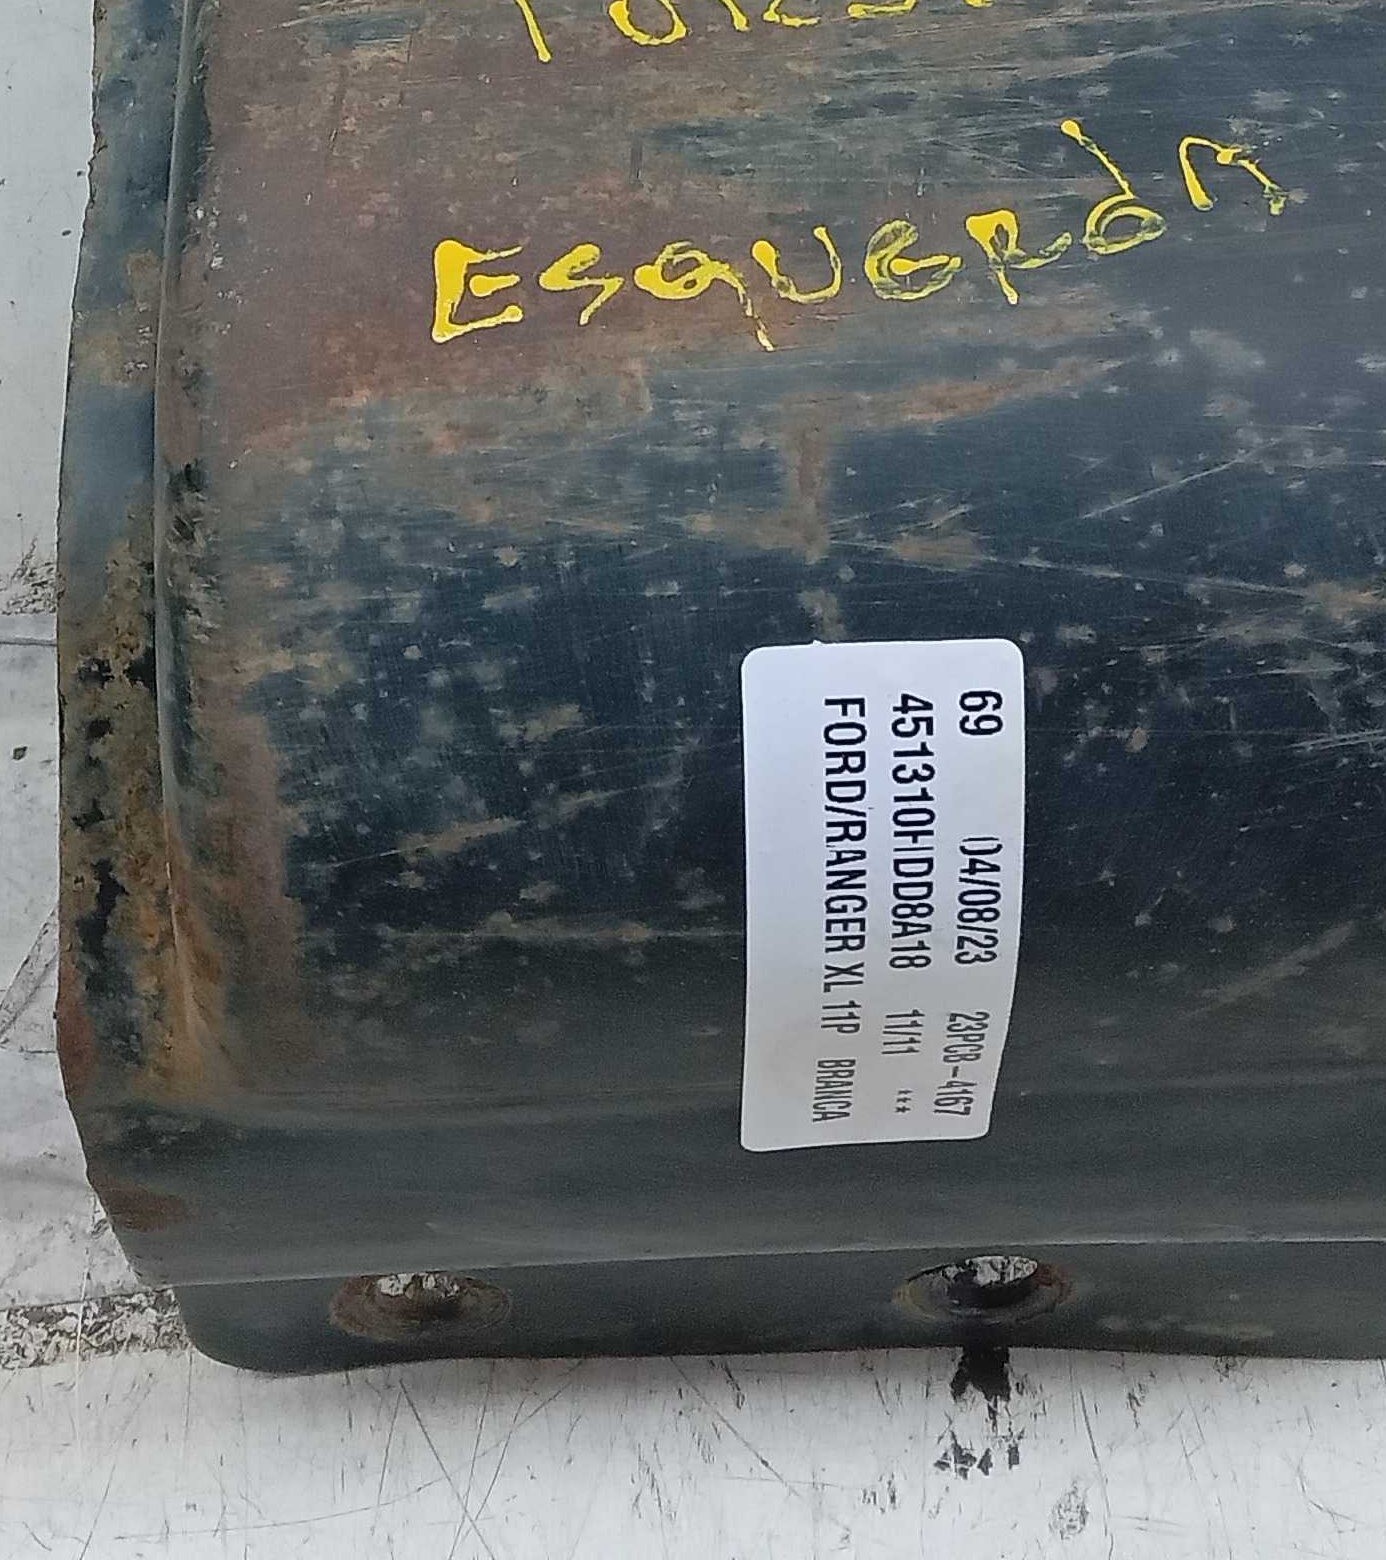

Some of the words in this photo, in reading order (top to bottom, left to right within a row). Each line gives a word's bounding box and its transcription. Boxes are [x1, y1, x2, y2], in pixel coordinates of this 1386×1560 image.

[957, 689, 1004, 737] 69
[822, 696, 868, 954] FORD/RANGER
[888, 692, 936, 970] 451310HDD8A18
[953, 836, 1004, 966] 04/08/23
[822, 960, 865, 993] XL
[819, 999, 862, 1035] 11P
[881, 1008, 926, 1056] 11/11
[811, 1057, 857, 1123] BRANCA
[933, 1010, 991, 1117] 23PCB-4167
